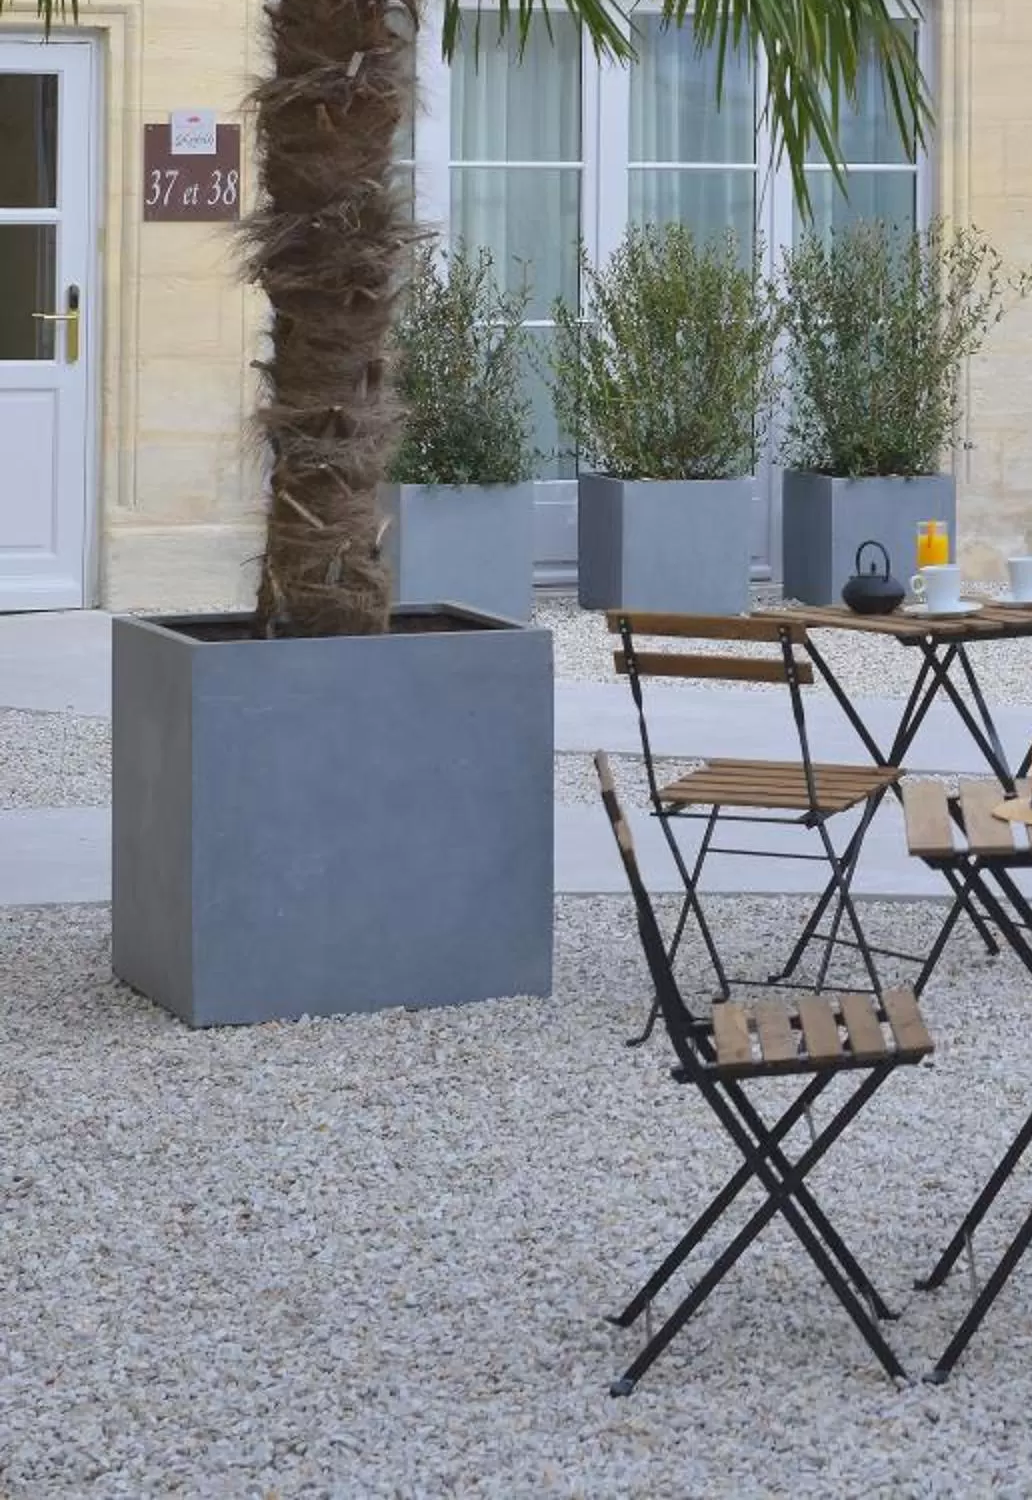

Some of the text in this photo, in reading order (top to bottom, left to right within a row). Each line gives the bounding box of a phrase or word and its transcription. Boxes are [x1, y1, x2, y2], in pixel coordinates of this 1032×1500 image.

[145, 169, 238, 206] 37 et 38
